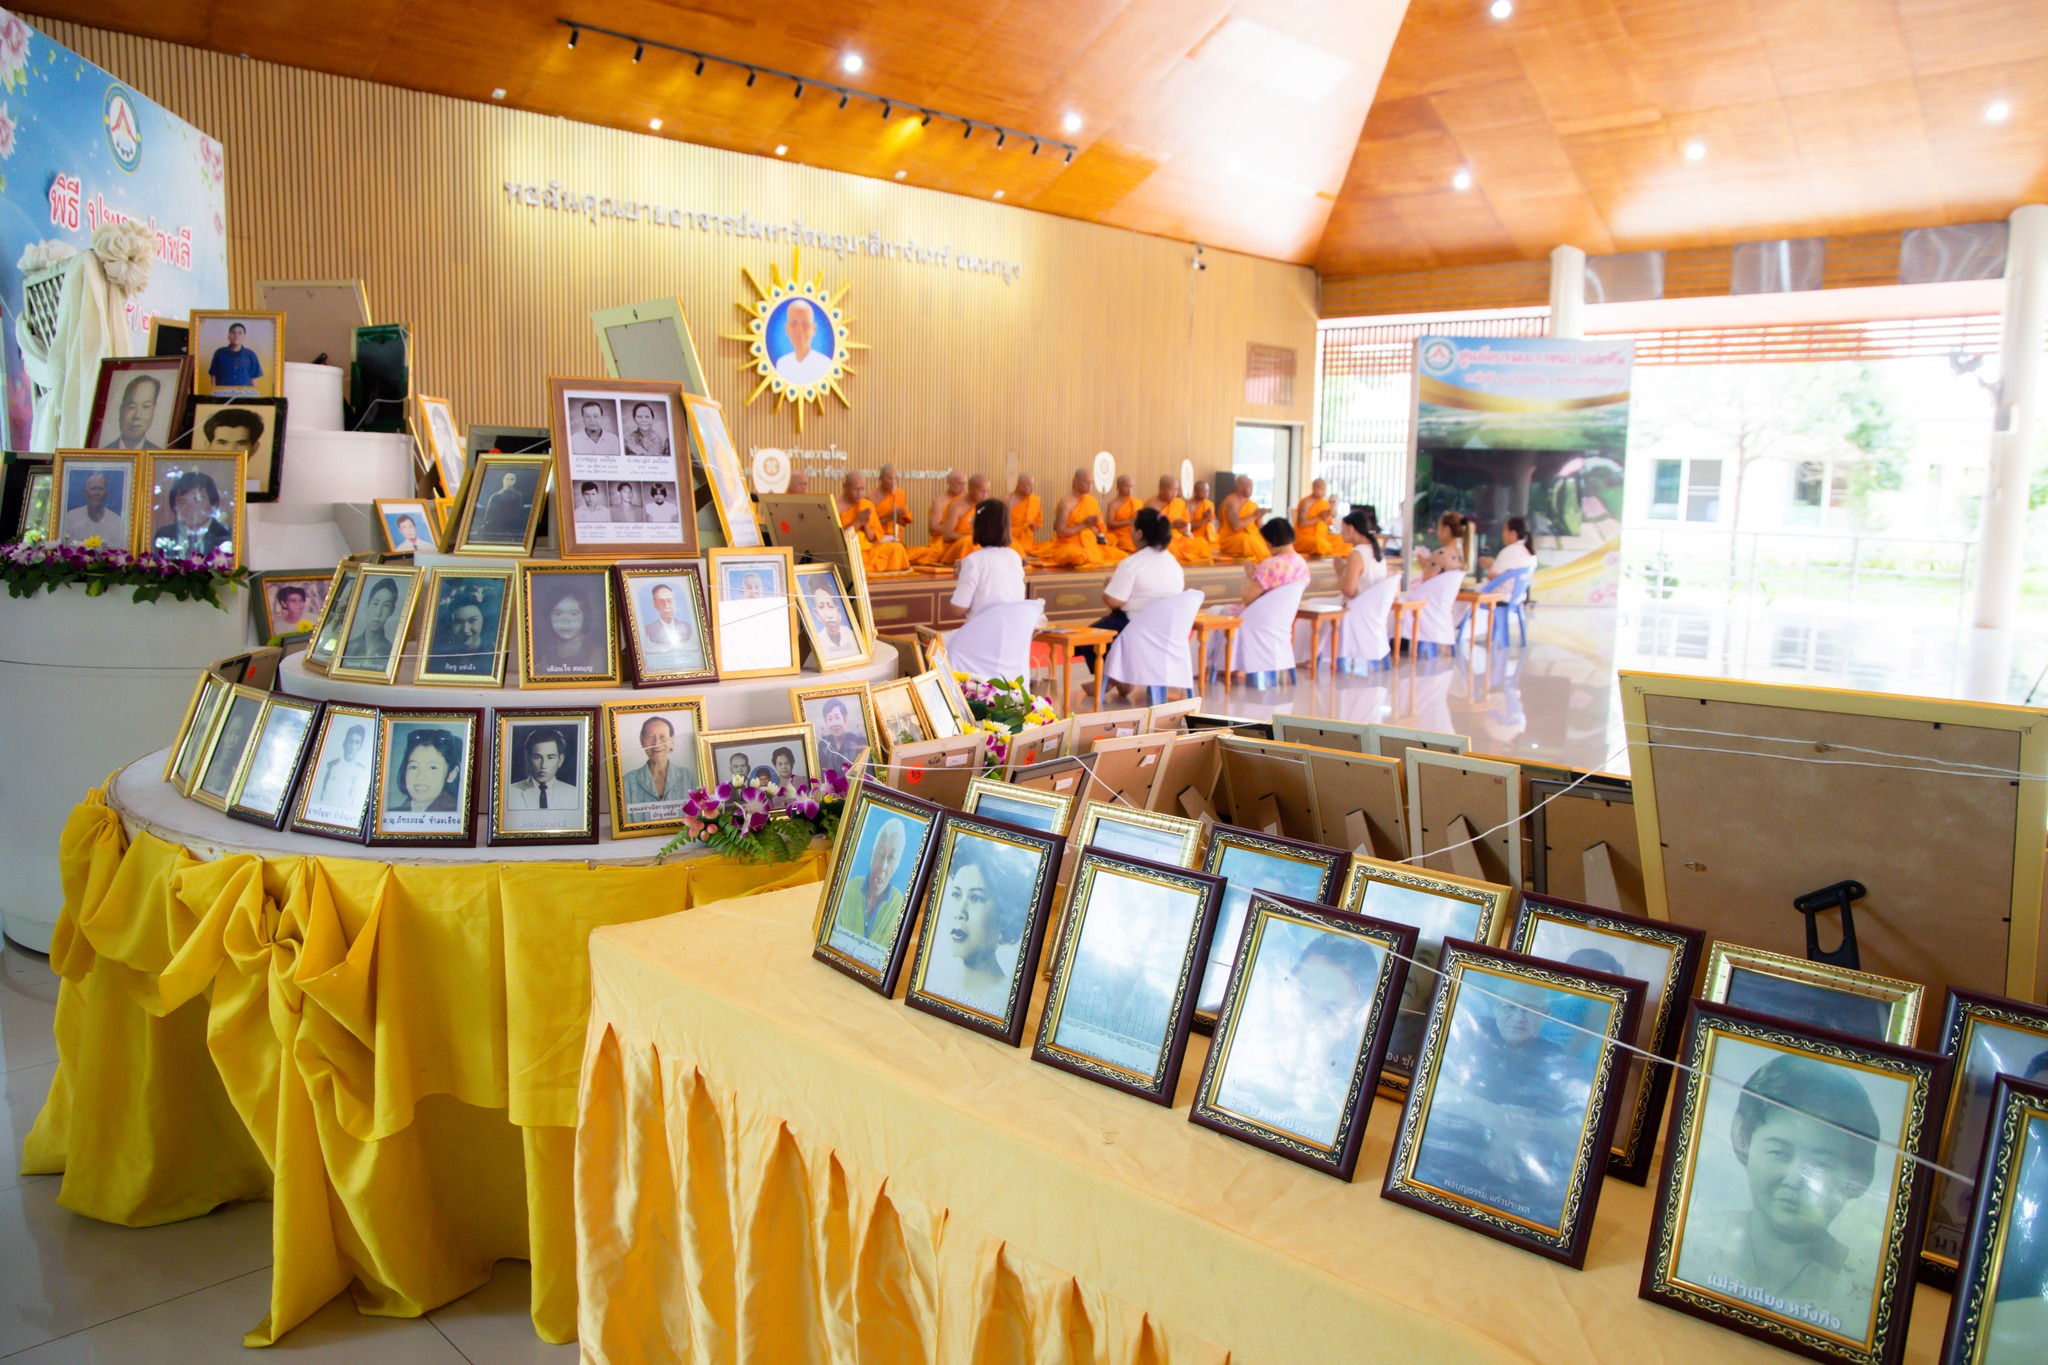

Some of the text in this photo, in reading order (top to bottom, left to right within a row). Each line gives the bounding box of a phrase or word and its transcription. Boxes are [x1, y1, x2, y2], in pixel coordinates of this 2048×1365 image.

[50, 175, 80, 229] พิธี
[1444, 1178, 1531, 1214] พ่อบุญธรรม แก้วประพล
[1934, 1234, 1960, 1255] นา
[1708, 1273, 1842, 1330] แม่สำเนียง หวังกิจ
